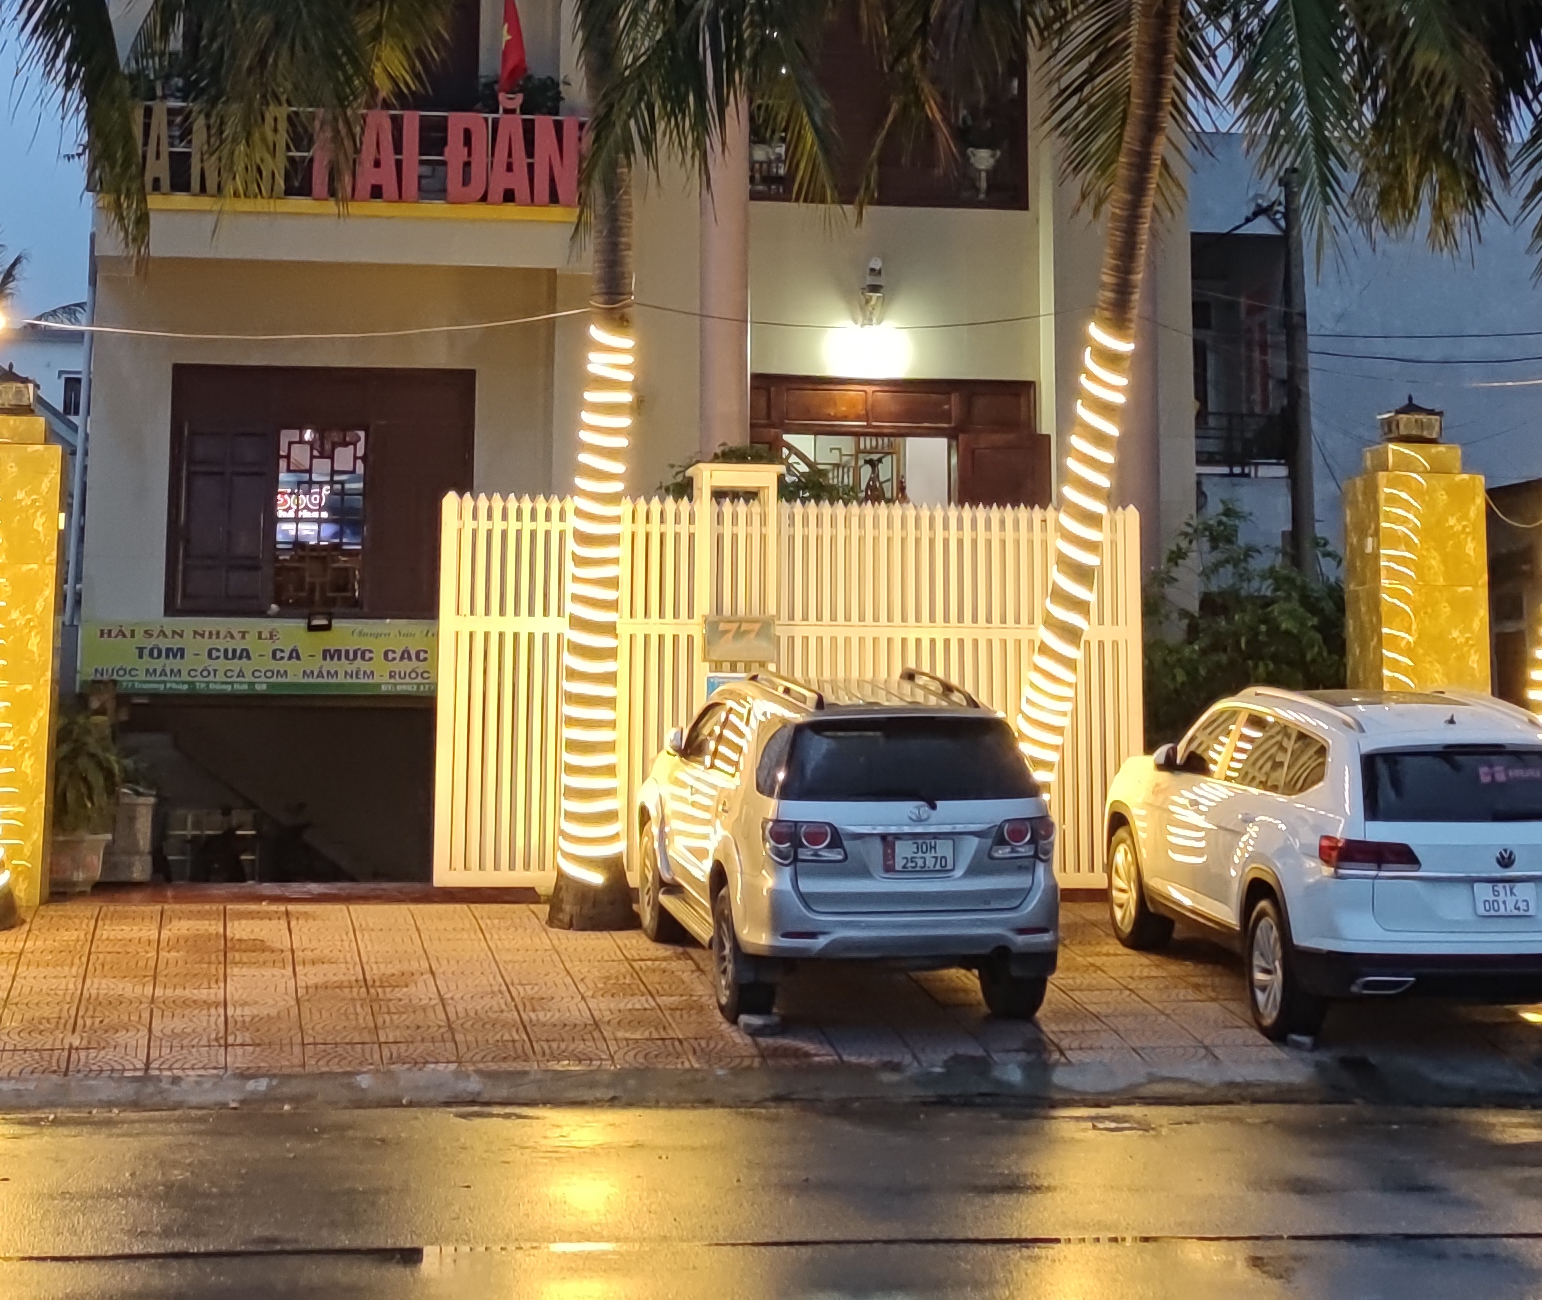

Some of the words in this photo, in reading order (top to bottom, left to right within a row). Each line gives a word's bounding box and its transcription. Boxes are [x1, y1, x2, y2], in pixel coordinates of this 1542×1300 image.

[444, 92, 585, 207] ĐĂN
[99, 625, 136, 639] HẢI
[142, 625, 185, 640] SẢN
[192, 627, 250, 643] NHẬT
[256, 627, 281, 643] LỆ
[718, 622, 762, 645] 77
[135, 644, 185, 660] TÔM
[207, 647, 252, 661] CUA
[271, 645, 302, 661] CÁ
[321, 646, 374, 665] MỰC
[383, 645, 428, 662] CÁC
[93, 665, 139, 678] NƯỚC
[145, 663, 182, 679] MẮM
[187, 664, 218, 678] CỐT
[224, 665, 246, 679] CÁ
[251, 668, 288, 680] CƠM
[302, 665, 339, 680] MẮM
[344, 666, 375, 680] NÊM
[388, 666, 431, 680] RUỐC
[911, 841, 937, 855] 30H
[901, 855, 948, 869] 253.70
[1492, 884, 1517, 897] 61K
[1483, 899, 1530, 912] 001.43
